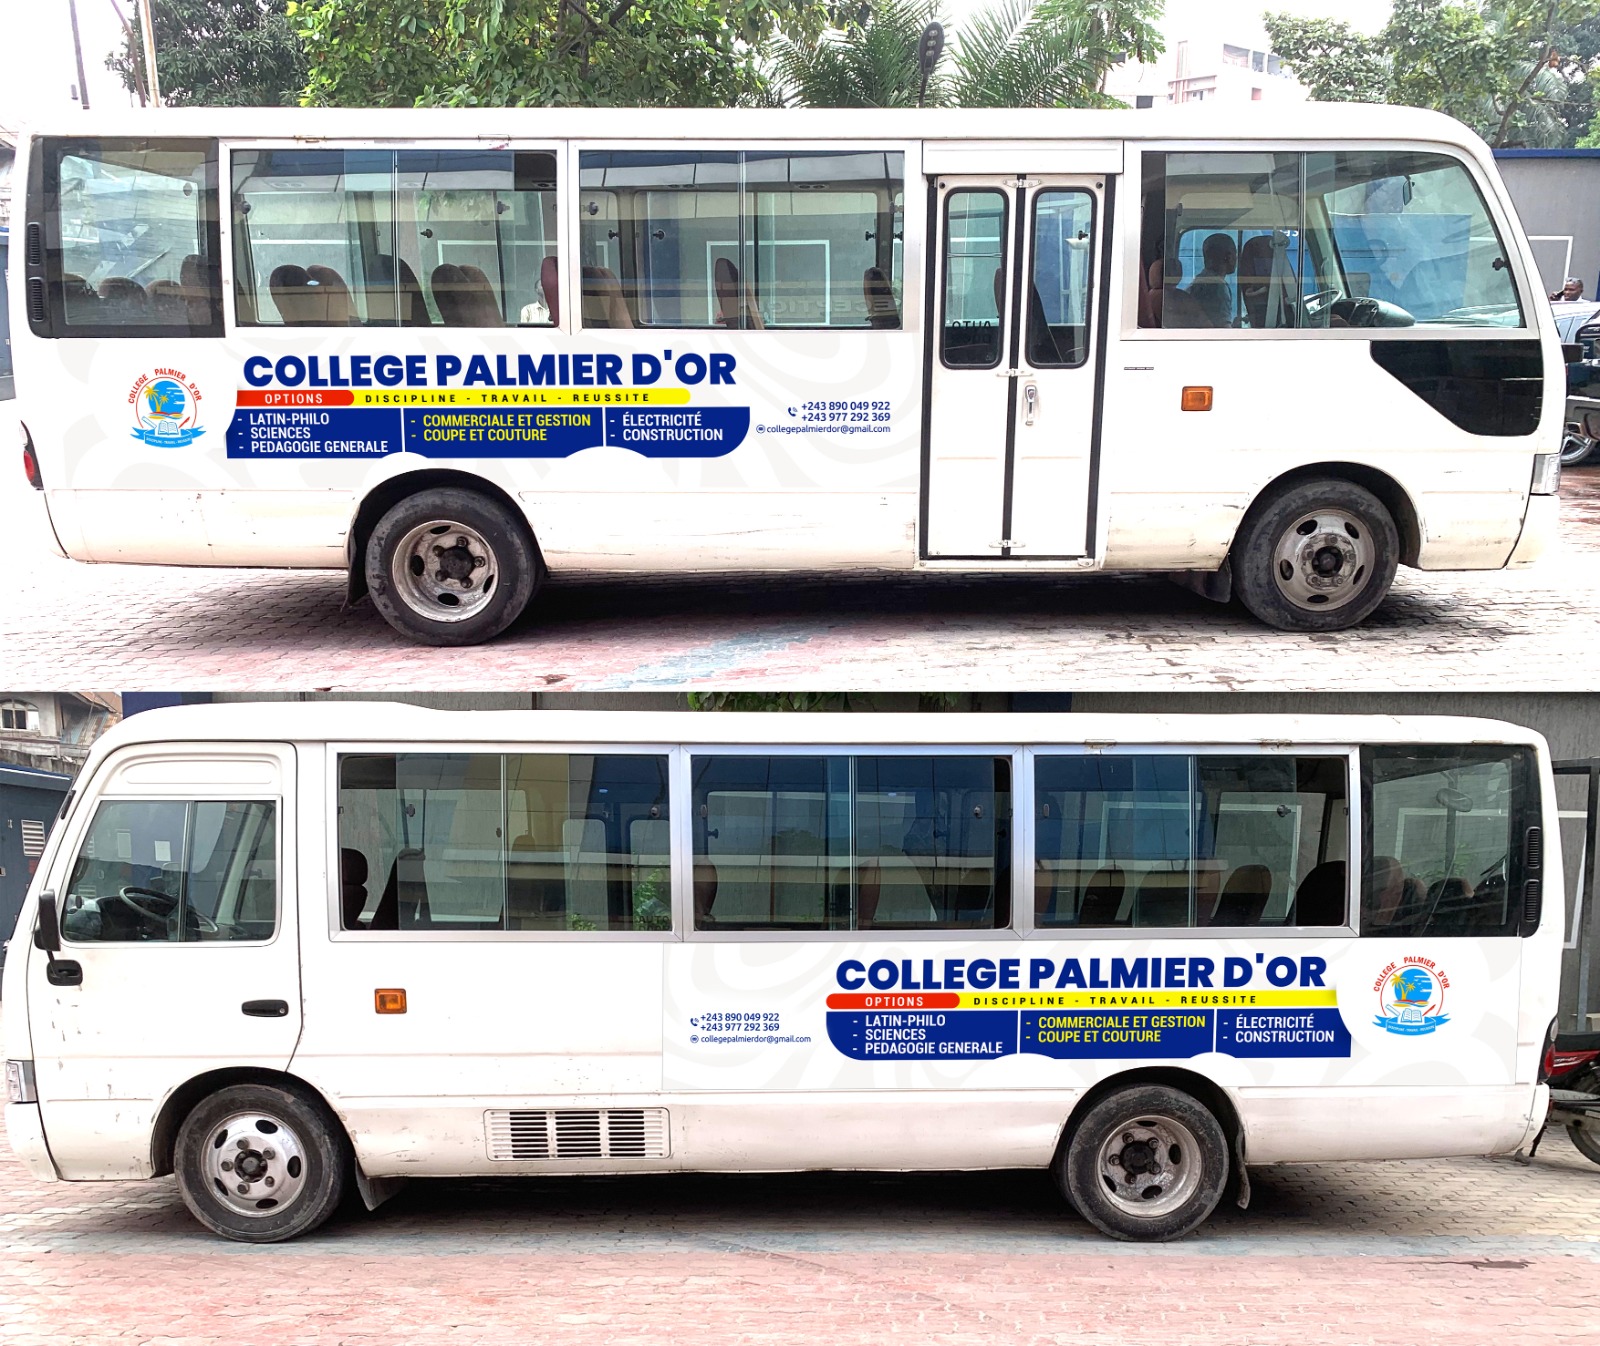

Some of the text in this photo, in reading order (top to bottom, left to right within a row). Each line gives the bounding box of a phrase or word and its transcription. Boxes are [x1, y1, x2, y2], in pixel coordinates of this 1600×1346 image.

[244, 350, 736, 387] COLLEGE PALMIER D'OR
[127, 367, 203, 404] COLLEGE PALMIER D'OR
[264, 393, 323, 404] OPTIONS
[365, 394, 456, 403] DISCIPLINE
[481, 394, 547, 402] TRAVAIL
[573, 393, 649, 402] REUSSITE
[801, 401, 891, 411] +243 890 049 922
[249, 413, 330, 425] LATIN-PHILO
[423, 414, 591, 426] COMMERCIALE ET GESTION
[623, 411, 702, 426] ÉLECTRICITÉ
[801, 412, 891, 422] +243 977 292 369
[250, 427, 311, 439] SCIENCES
[423, 429, 548, 441] COUPE ET COUTURE
[623, 428, 723, 441] CONSTRUCTION
[766, 424, 891, 435] collegepalmierdor@gmail.com
[251, 440, 389, 453] PEDAGOGIE GENERALE
[836, 953, 1326, 990] COLLEGE PALMIER D'OR
[1373, 956, 1451, 992] COLLEGE PALMIER D'OR
[865, 996, 924, 1007] OPTIONS
[973, 996, 1064, 1005] DISCIPLINE
[1089, 996, 1155, 1005] TRAVAIL
[1180, 995, 1256, 1004] REUSSITE
[700, 1013, 780, 1021] +243 890 049 922
[865, 1015, 946, 1027] LATIN-PHILO
[1038, 1015, 1206, 1028] COMMERCIALE ET GESTION
[1236, 1014, 1315, 1029] ÉLECTRICITÉ
[700, 1023, 780, 1031] +243 977 292 369
[700, 1034, 811, 1044] collegepalmierdor@gmail.com
[865, 1028, 926, 1041] SCIENCES
[1038, 1030, 1162, 1043] COUPE ET COUTURE
[1235, 1030, 1335, 1043] CONSTRUCTION
[865, 1041, 1003, 1054] PEDAGOGIE GENERALE
